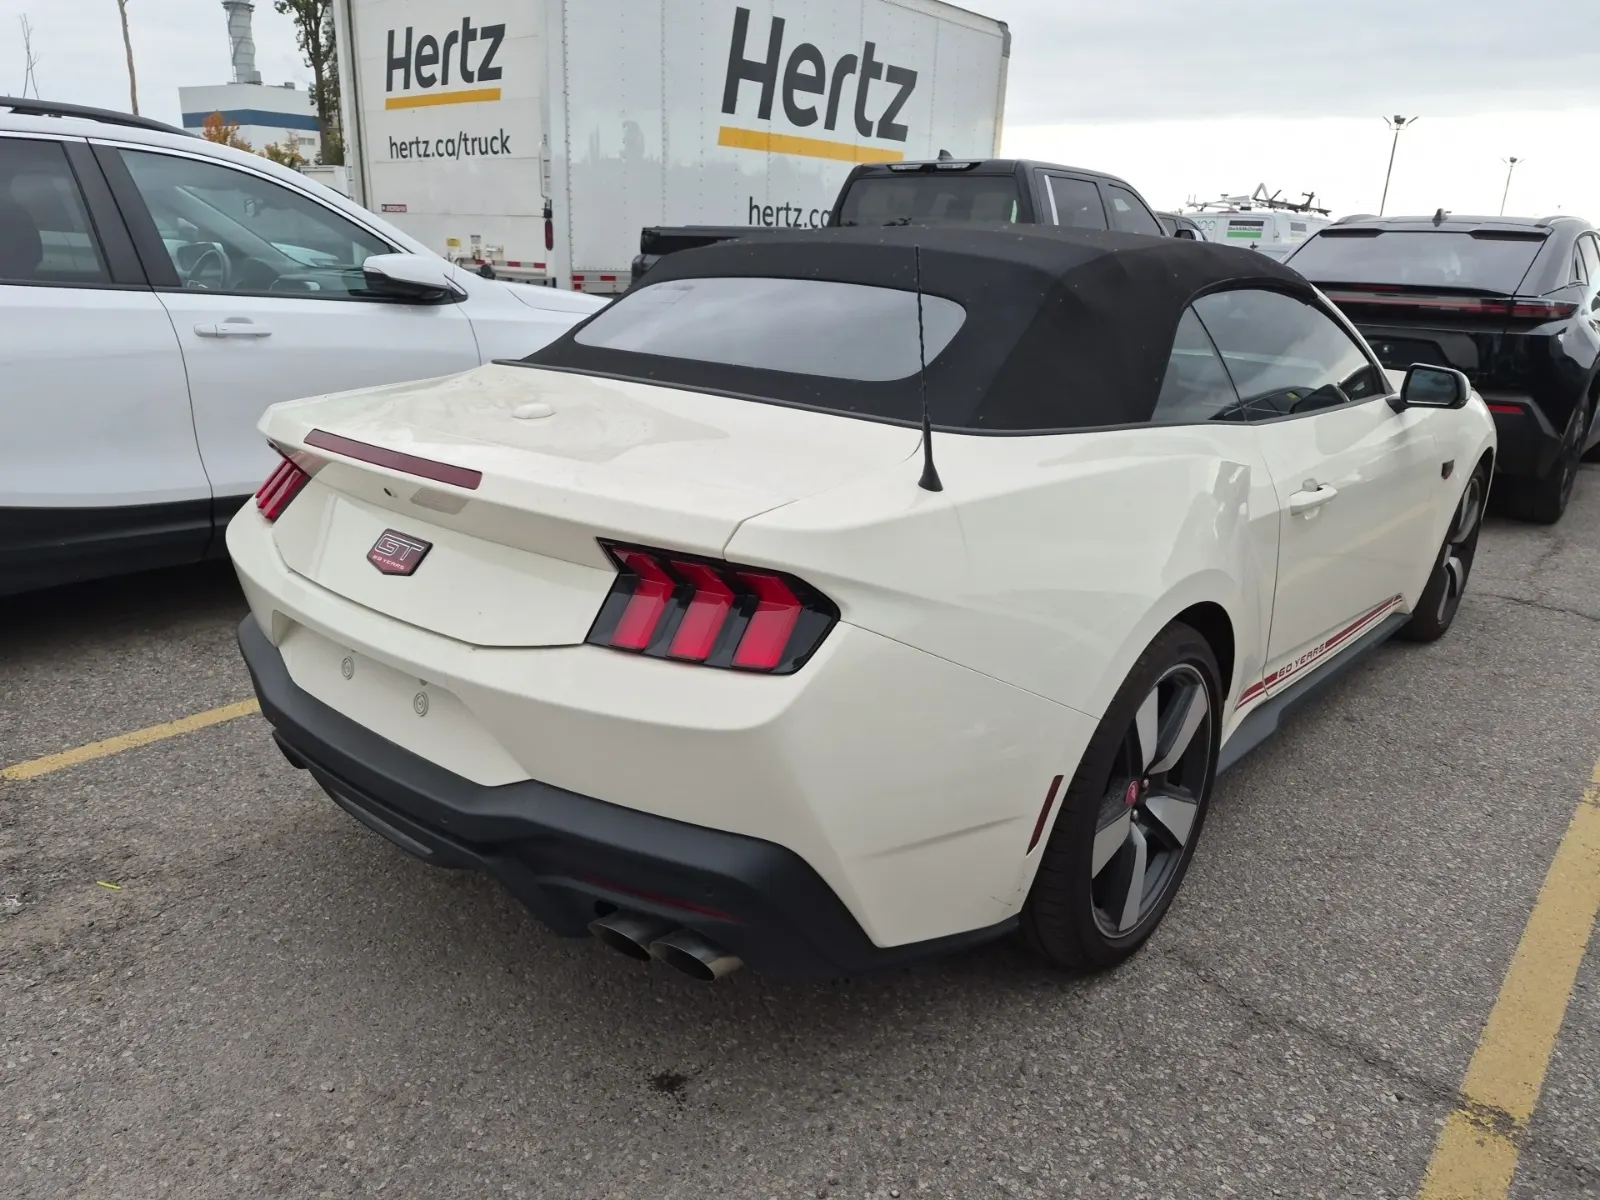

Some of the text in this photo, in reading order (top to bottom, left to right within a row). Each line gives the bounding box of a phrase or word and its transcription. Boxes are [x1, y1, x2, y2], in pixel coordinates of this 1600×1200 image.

[386, 16, 506, 92] Hertz
[721, 6, 918, 142] Hertz
[389, 128, 511, 160] hertz.ca/truck
[375, 533, 425, 561] GT
[383, 559, 405, 569] YEARS
[1278, 643, 1325, 678] 60 YEARS
